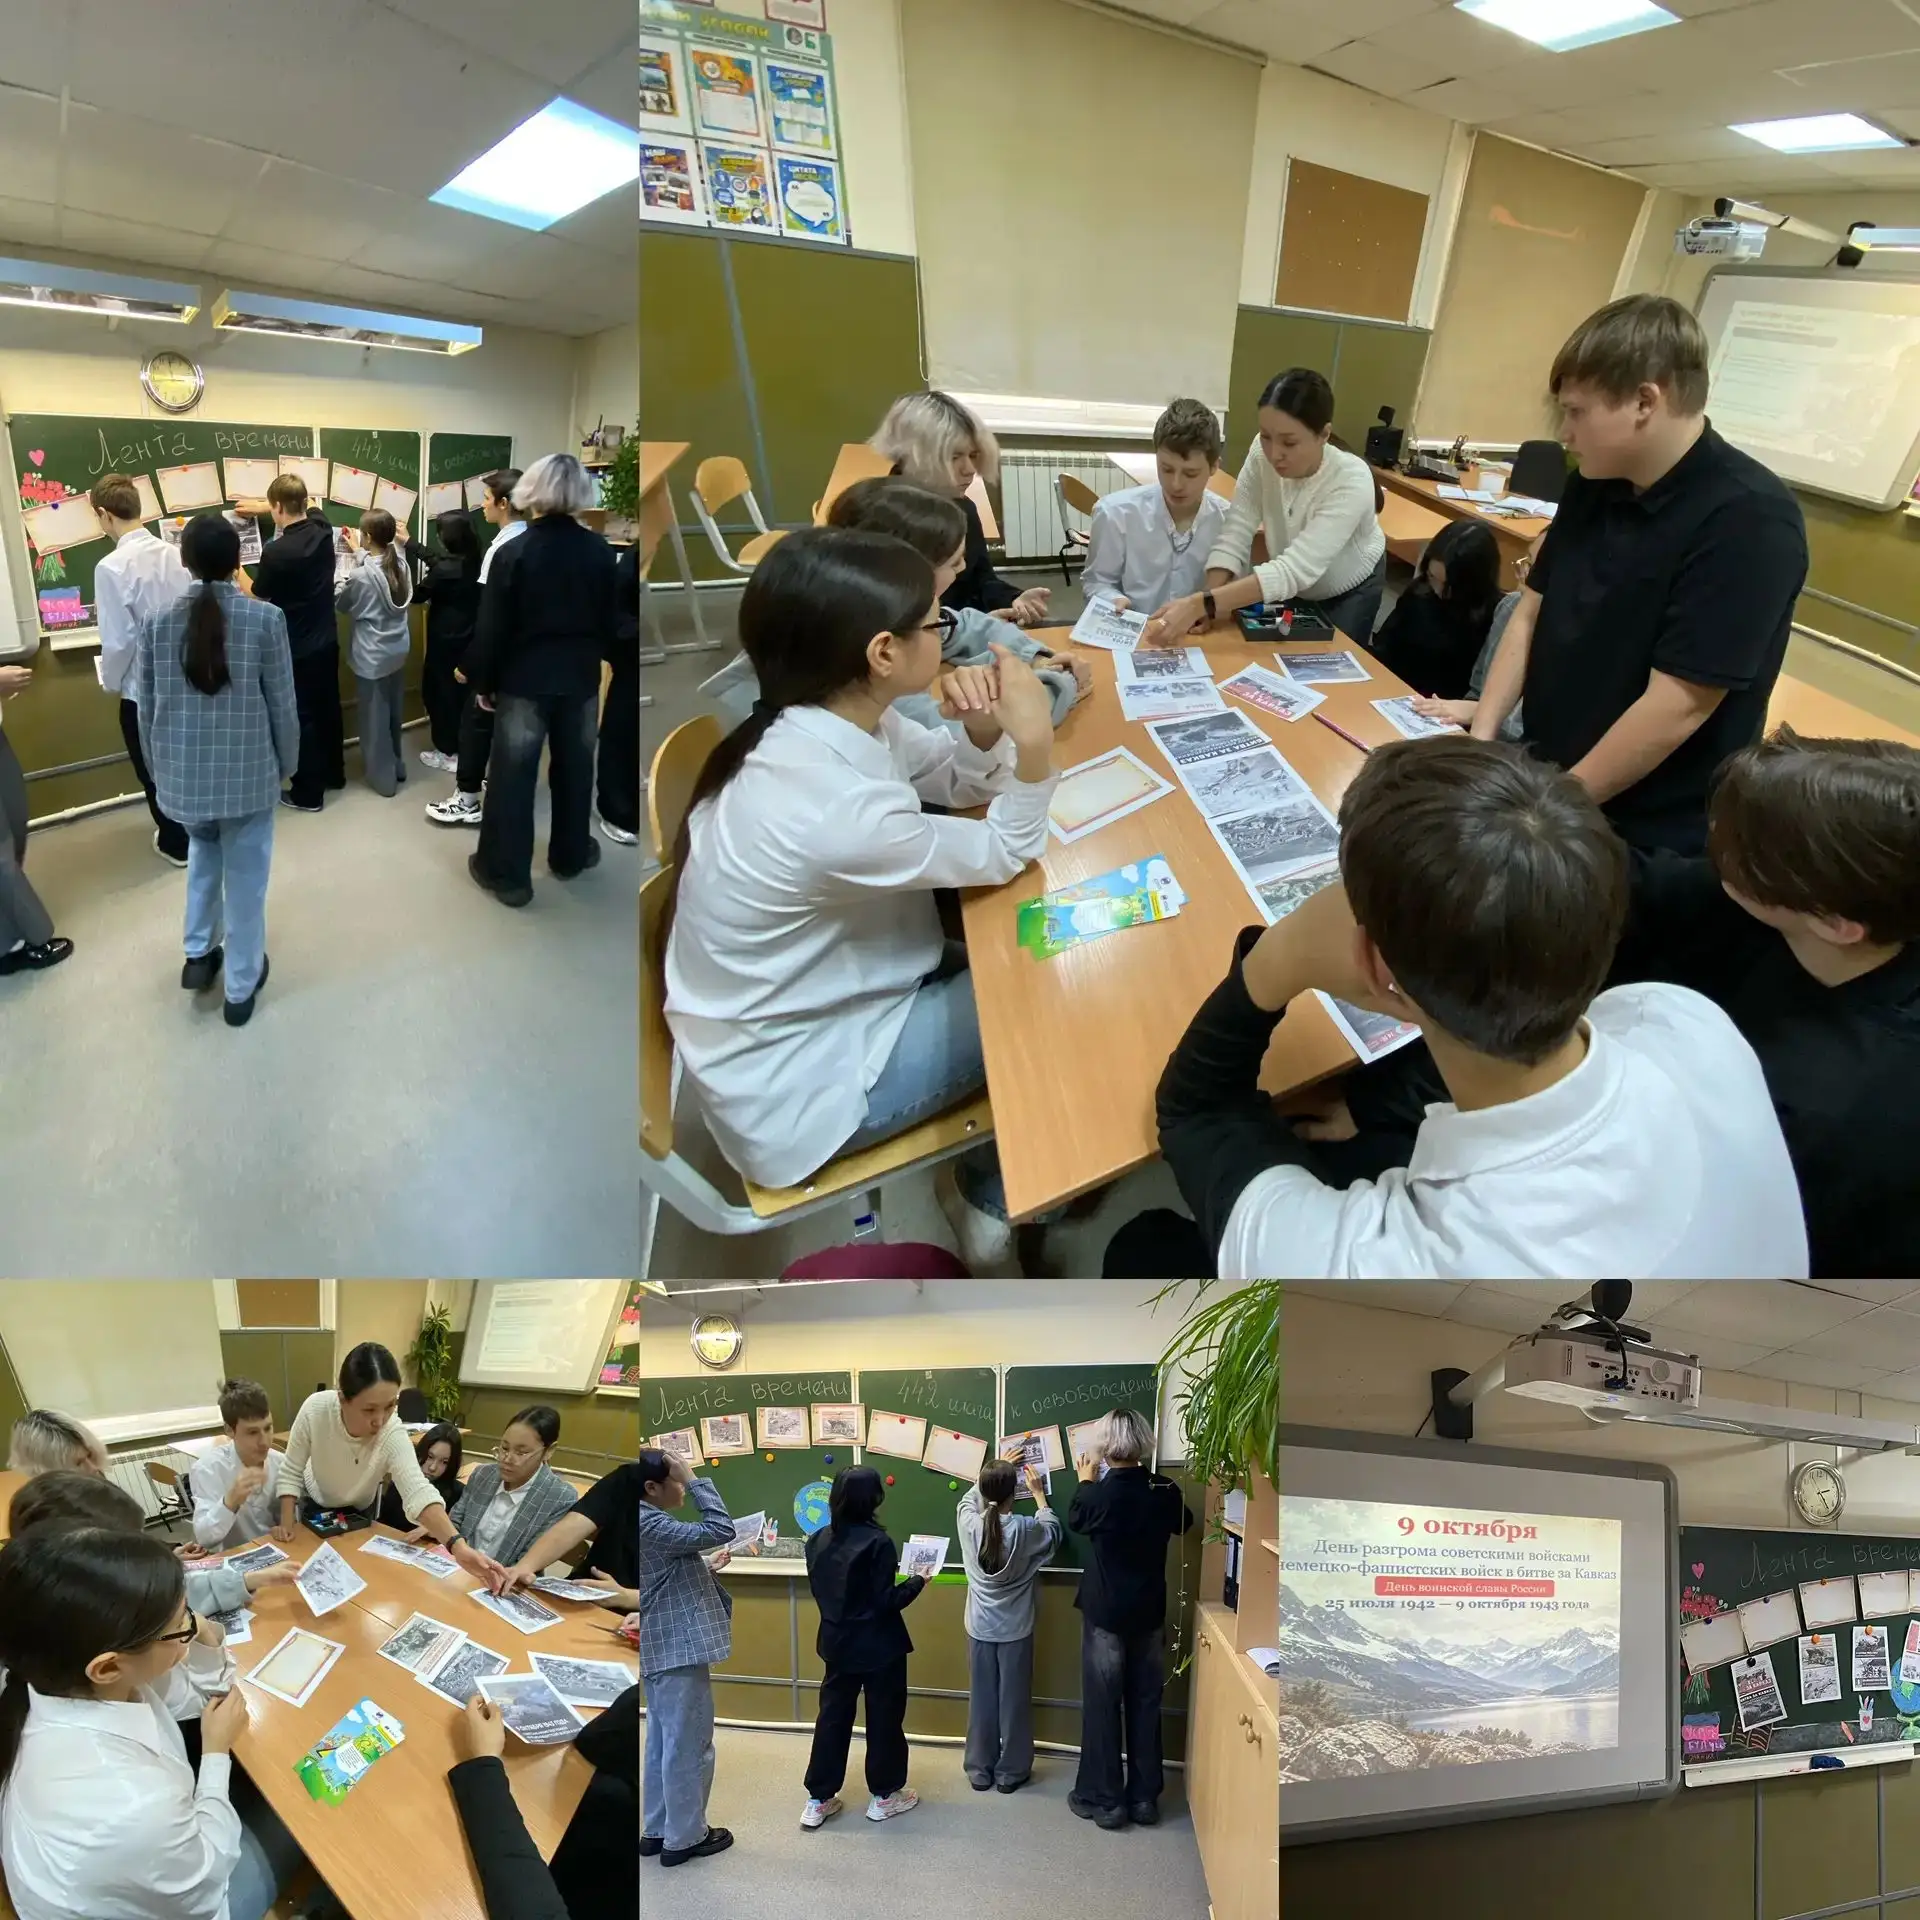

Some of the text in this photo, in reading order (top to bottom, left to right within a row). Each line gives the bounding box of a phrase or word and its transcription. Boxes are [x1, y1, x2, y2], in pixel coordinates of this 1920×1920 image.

[88, 427, 195, 475] Лента
[652, 1380, 850, 1426] Лента времени
[897, 1377, 939, 1409] 442
[1397, 1516, 1538, 1543] 9 октября
[1313, 1539, 1590, 1563] День разгрома советскими войсками
[1461, 1564, 1503, 1577] войск
[1506, 1568, 1514, 1577] в
[1516, 1566, 1555, 1579] битве
[1557, 1570, 1572, 1579] за
[1575, 1568, 1617, 1580] Кавказ
[1740, 1541, 1835, 1589] Лента
[1384, 1581, 1547, 1594] День воинской славы России
[1325, 1599, 1344, 1610] 25
[1349, 1599, 1395, 1609] июля
[1400, 1599, 1436, 1611] 1942
[1456, 1600, 1465, 1610] 9
[1468, 1598, 1526, 1611] октября
[1530, 1600, 1560, 1612] 1943
[1562, 1601, 1590, 1610] года
